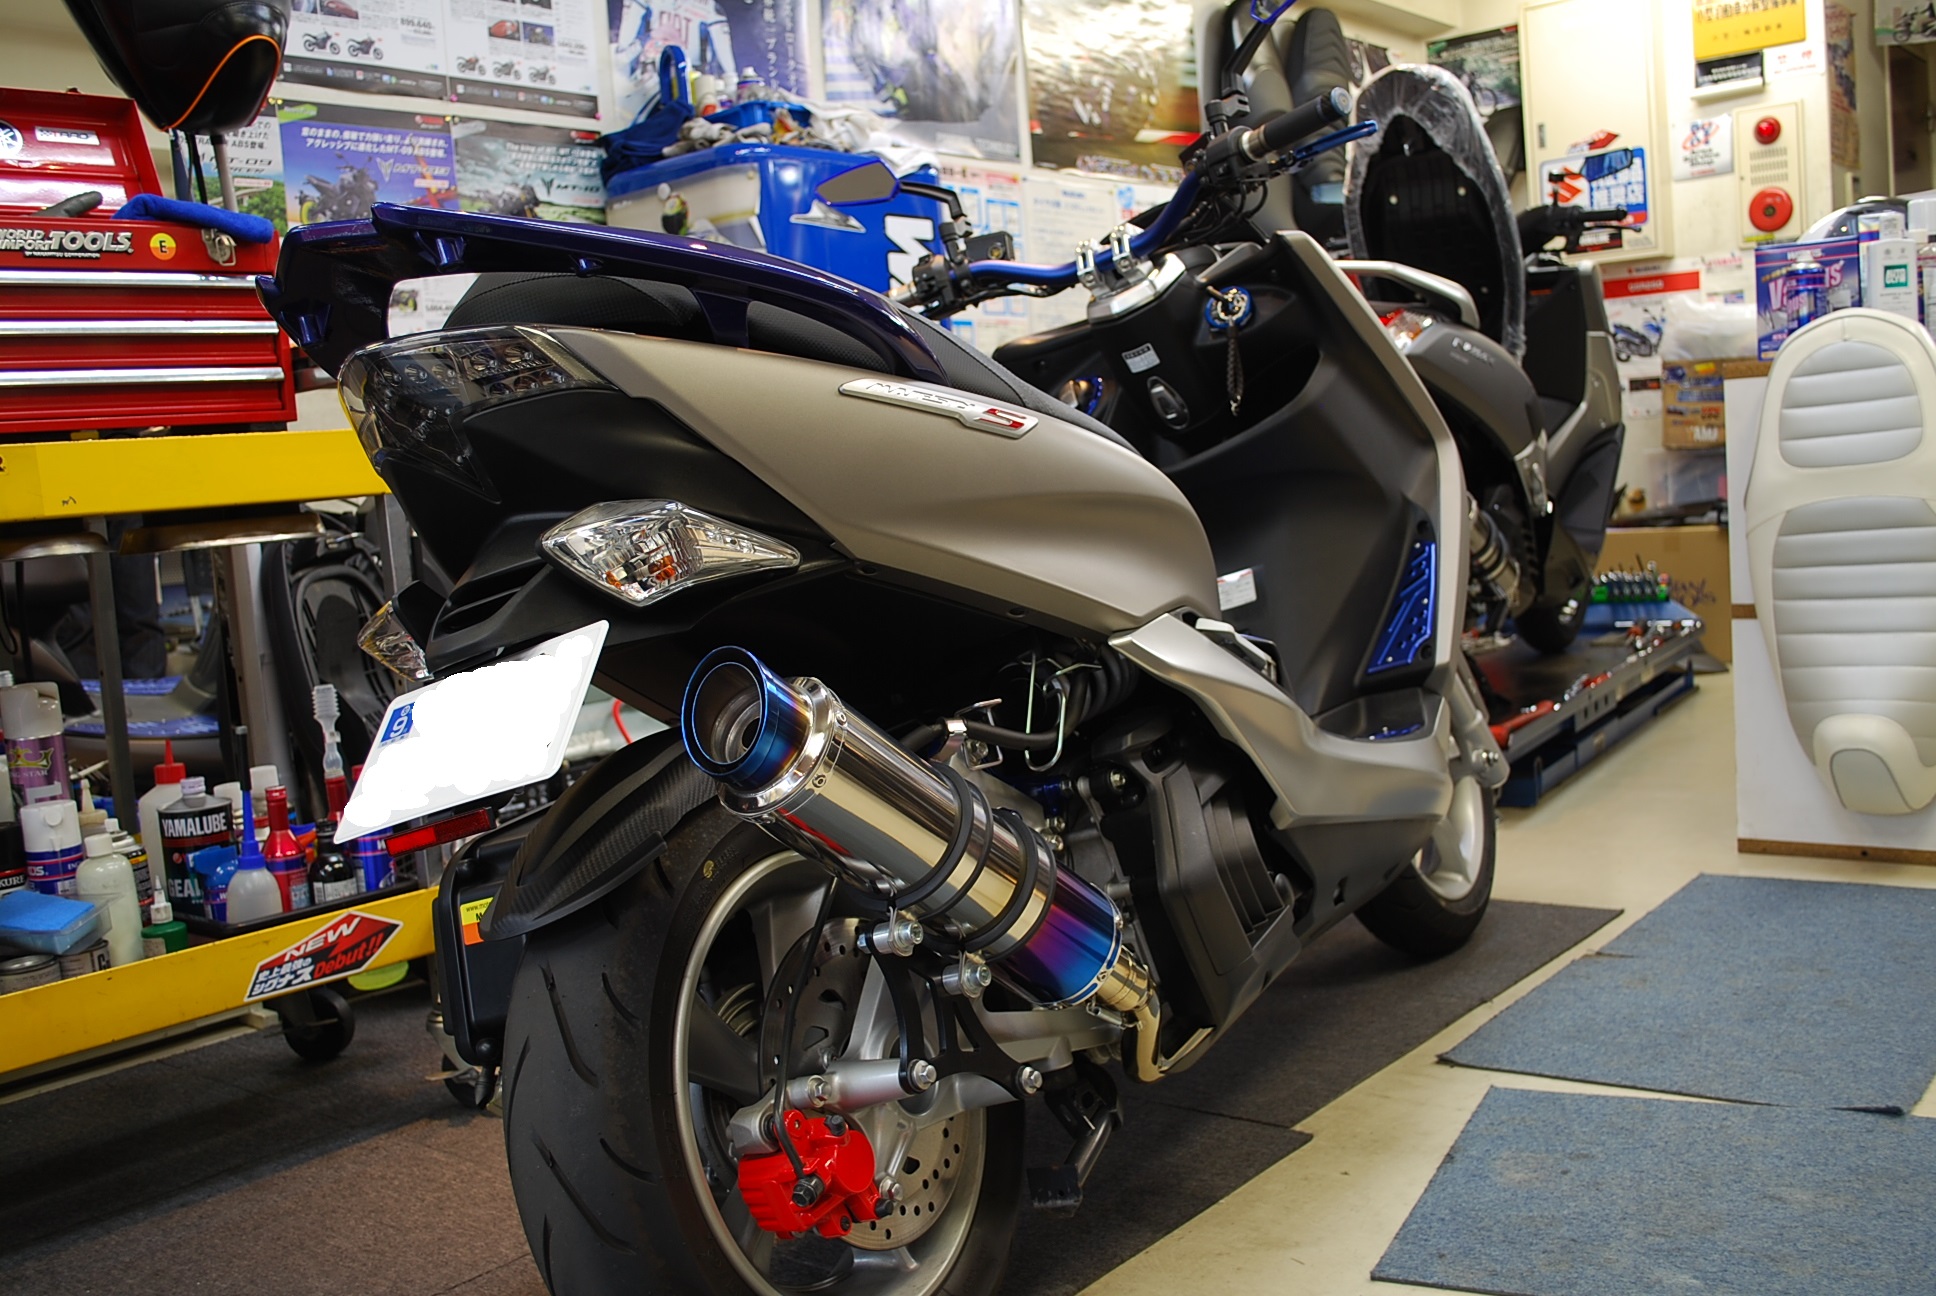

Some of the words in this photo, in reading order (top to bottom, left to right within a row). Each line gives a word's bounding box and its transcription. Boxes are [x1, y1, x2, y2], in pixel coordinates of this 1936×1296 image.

[158, 240, 168, 253] E
[161, 812, 228, 838] YAMALUBE
[283, 916, 362, 962] NEW
[313, 932, 385, 979] Debut!!
[251, 965, 315, 996] シグナス
[256, 957, 313, 983] 史上最強の
